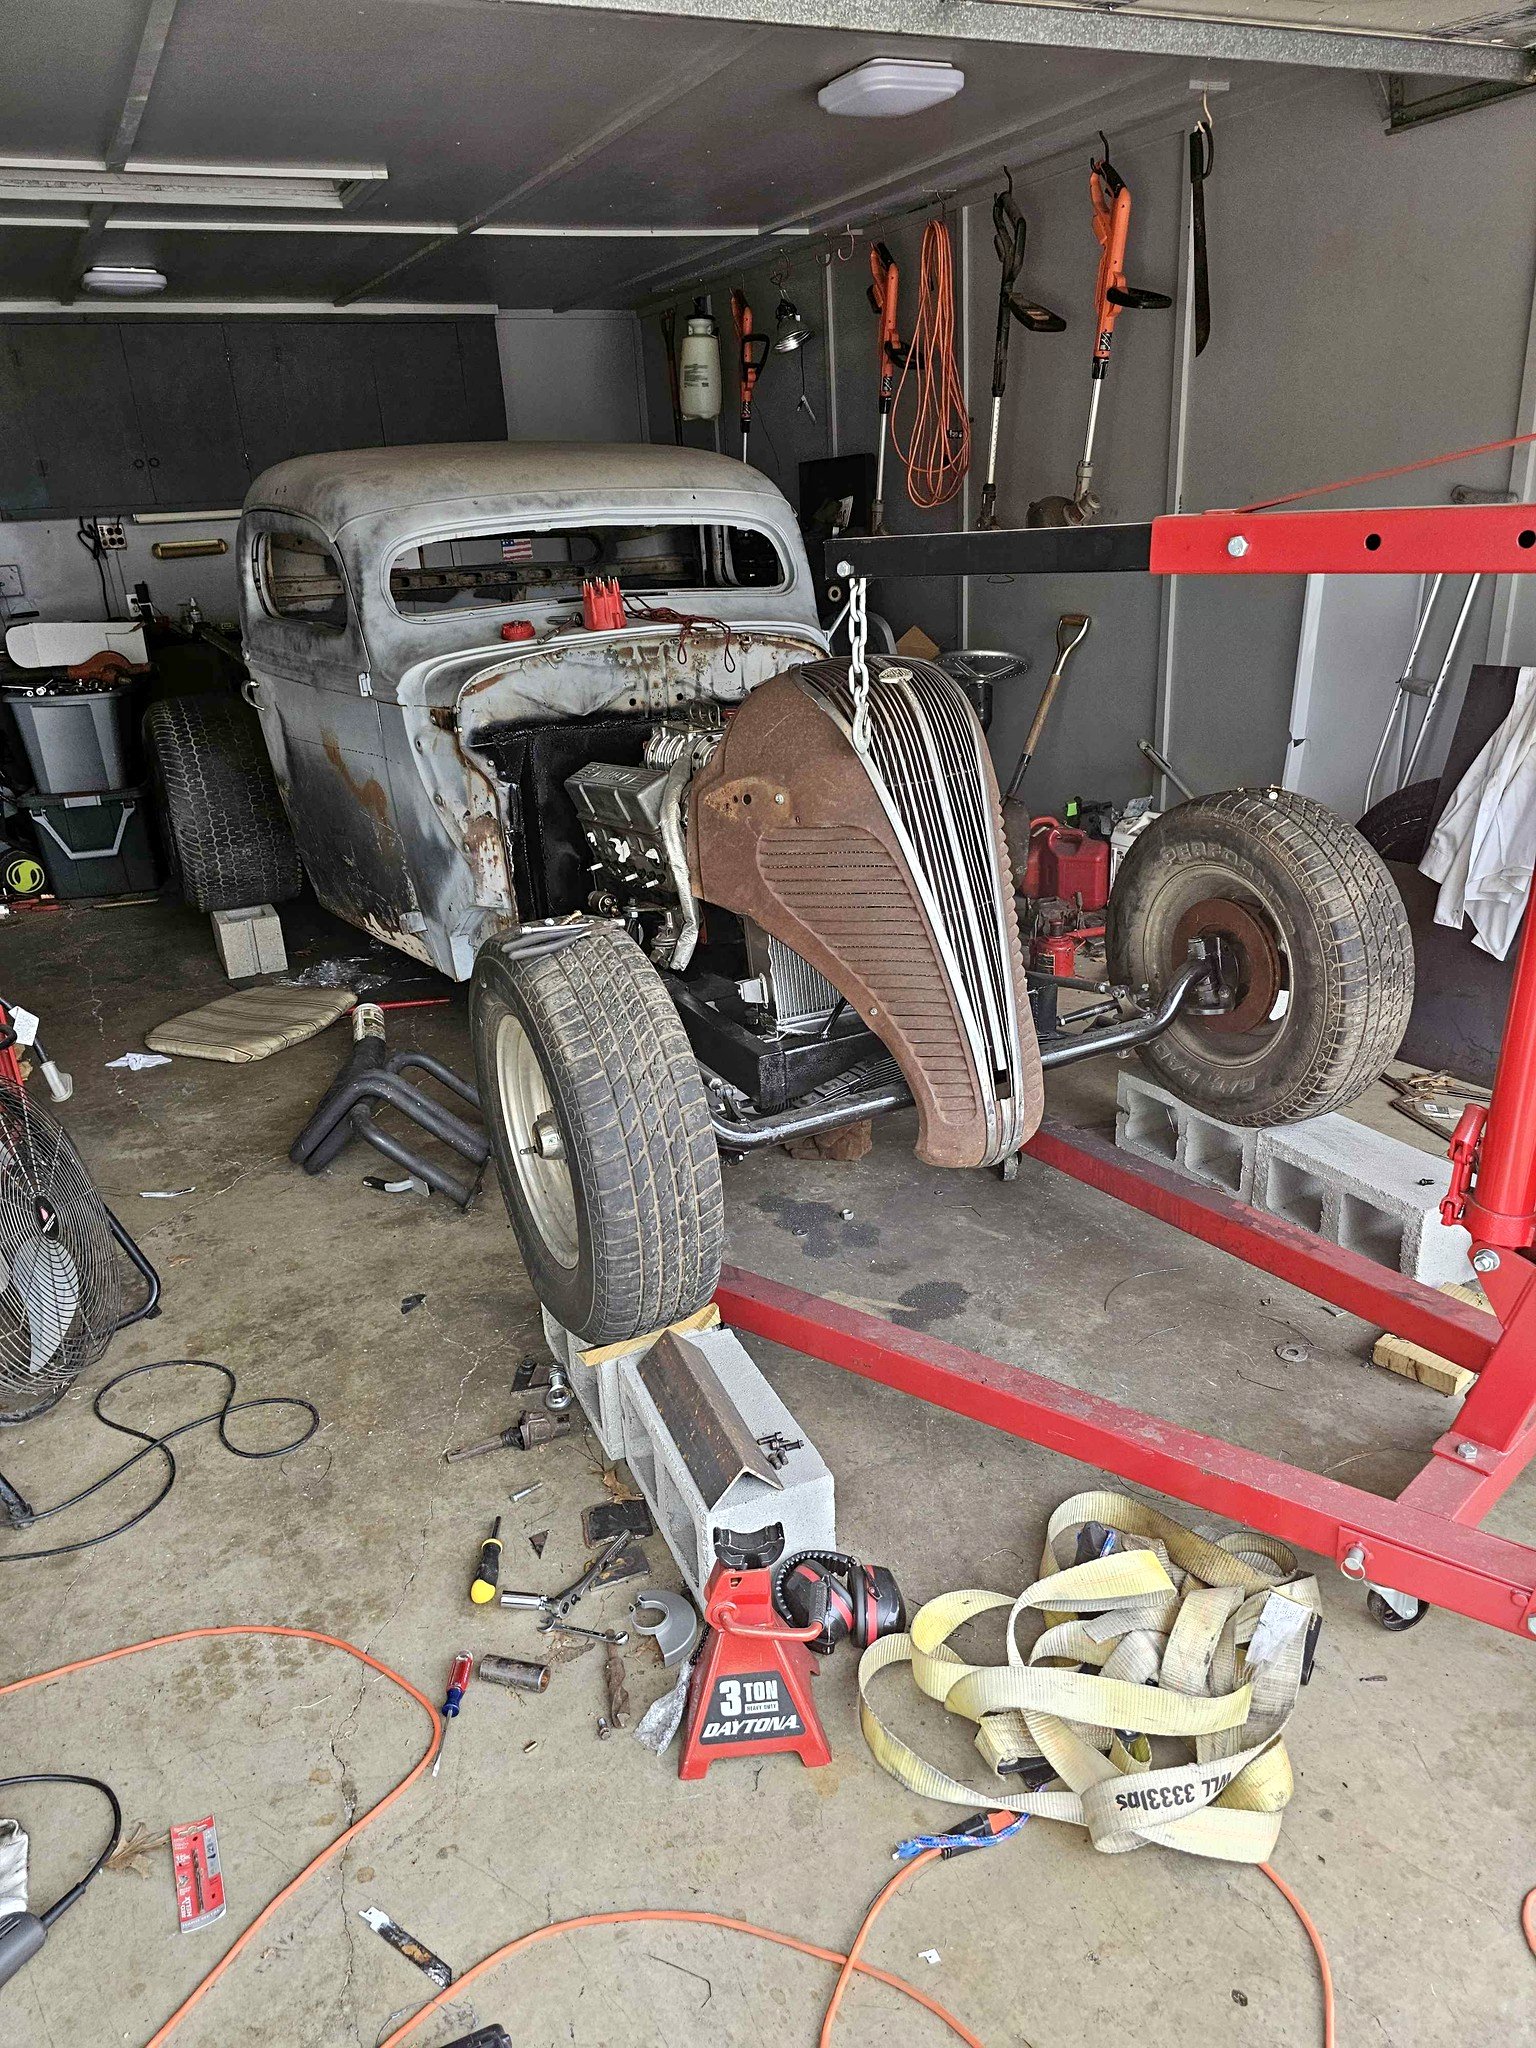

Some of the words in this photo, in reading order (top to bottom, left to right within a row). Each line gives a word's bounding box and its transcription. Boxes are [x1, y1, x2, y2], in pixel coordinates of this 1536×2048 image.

[719, 1680, 742, 1717] 3
[743, 1680, 778, 1702] TON
[746, 1703, 762, 1711] HEAVY
[702, 1714, 800, 1738] DAYTONA
[1201, 1772, 1231, 1797] WLL
